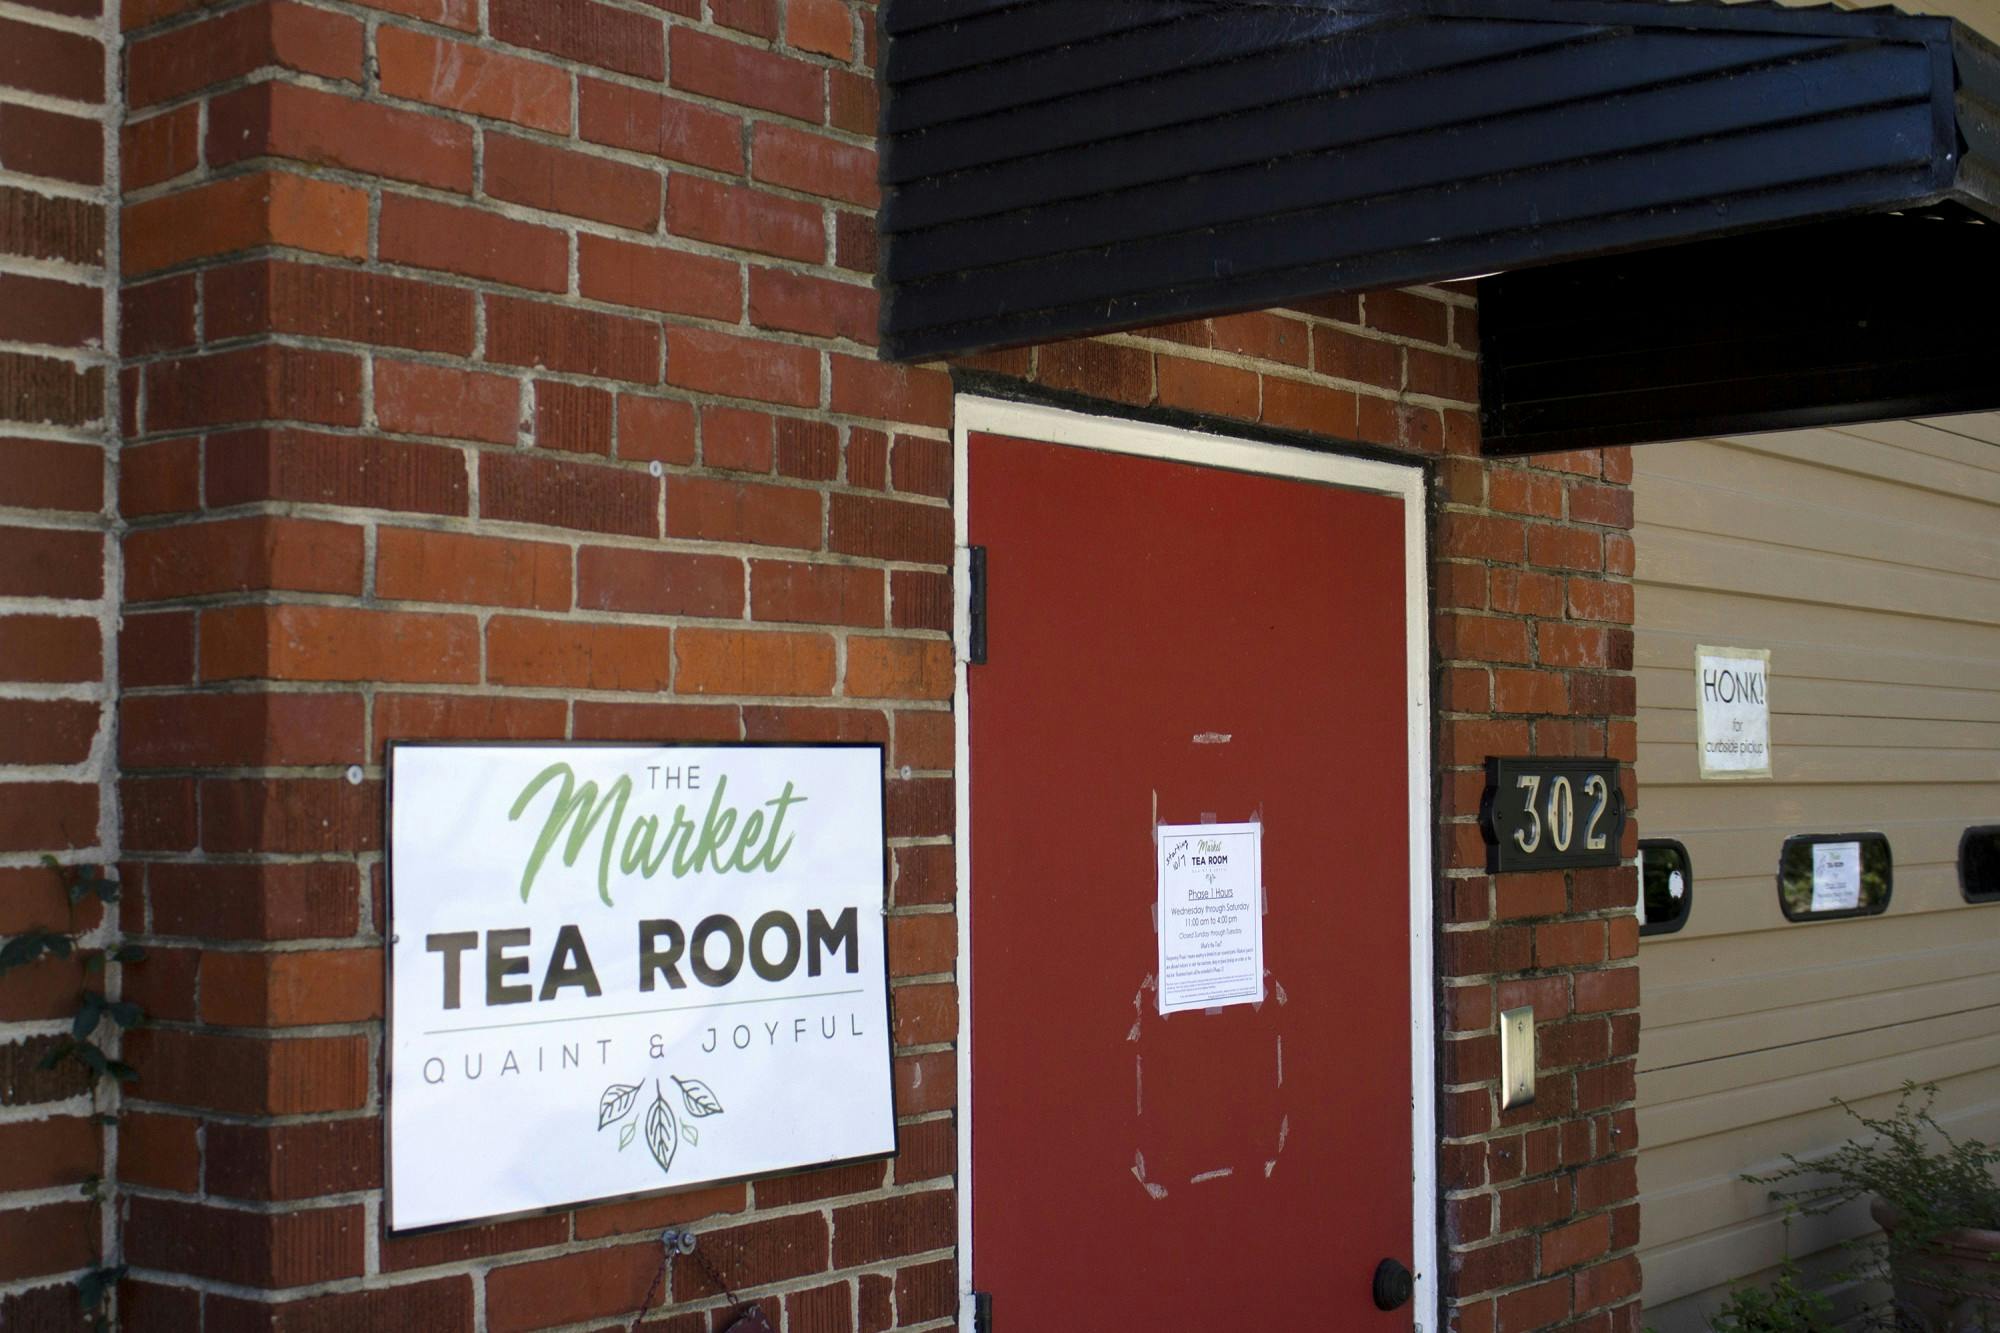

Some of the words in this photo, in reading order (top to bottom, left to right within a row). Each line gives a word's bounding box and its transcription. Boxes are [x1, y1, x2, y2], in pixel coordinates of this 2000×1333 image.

[1703, 669, 1764, 705] HONK!
[1732, 719, 1744, 733] for
[1704, 738, 1739, 754] curbside
[1739, 738, 1764, 756] pickup
[647, 766, 701, 790] THE
[1513, 773, 1608, 853] 302
[507, 761, 808, 907] Market
[1191, 856, 1206, 866] TEA
[1208, 855, 1228, 865] ROOM
[1188, 889, 1209, 900] Phase
[1215, 888, 1234, 899] Hours
[1171, 906, 1204, 917] Wednesday
[1205, 904, 1225, 914] through
[1226, 902, 1249, 912] Saturday
[1185, 917, 1199, 927] 11:00
[1199, 918, 1209, 926] am
[1210, 916, 1216, 925] to
[1228, 915, 1238, 924] pm
[426, 924, 602, 1010] TEA
[638, 907, 859, 993] ROOM
[423, 1039, 612, 1085] QUAINT
[648, 1034, 665, 1061] &
[702, 1013, 864, 1054] JOYFUL
